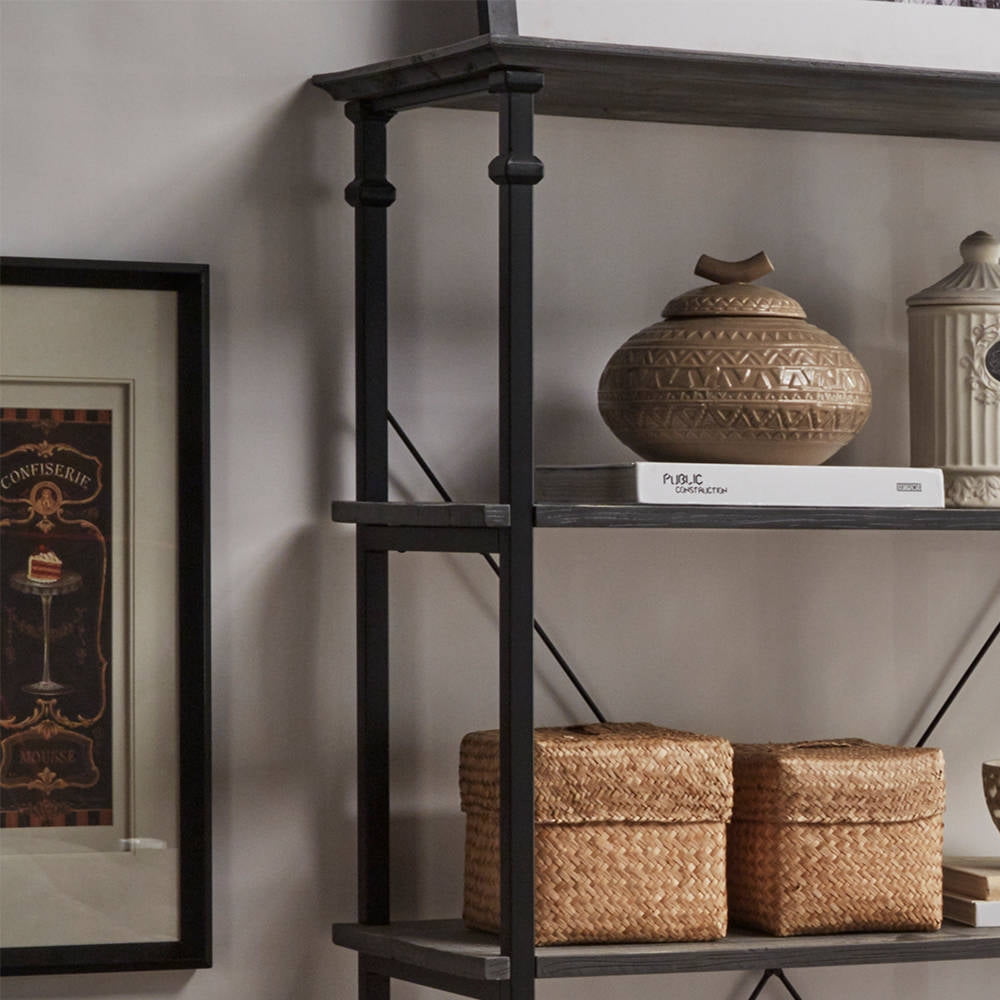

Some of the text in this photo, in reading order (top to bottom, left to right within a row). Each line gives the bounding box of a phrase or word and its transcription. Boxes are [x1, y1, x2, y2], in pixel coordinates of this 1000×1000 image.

[0, 462, 92, 489] CONFISERIE
[663, 473, 704, 485] PUBLIC
[675, 485, 728, 494] CONSTRUCTION
